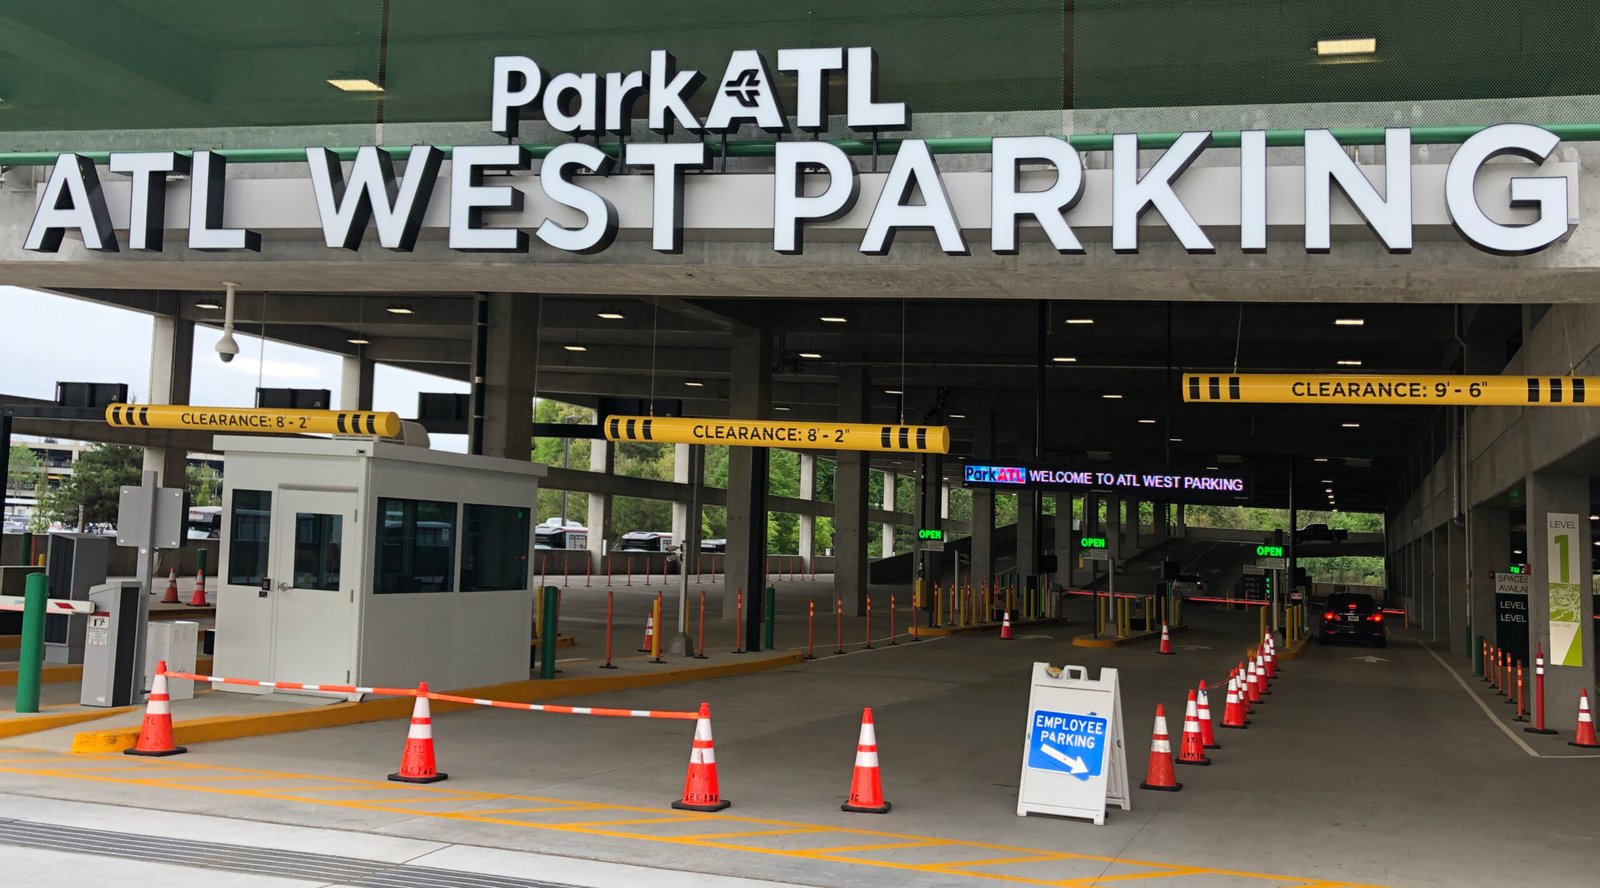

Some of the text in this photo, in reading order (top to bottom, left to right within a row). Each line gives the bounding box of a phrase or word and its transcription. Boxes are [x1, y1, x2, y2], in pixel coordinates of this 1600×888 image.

[491, 46, 907, 133] ParkATL
[23, 123, 1568, 254] ATL WEST PARKING
[1292, 382, 1427, 398] CLEARANCE:
[181, 412, 272, 428] CLEARANCE:
[693, 425, 802, 442] CLEARANCE:
[966, 466, 1243, 491] ParkATL WELCOME TO ATL WEST PARKING
[1549, 520, 1577, 530] LEVEL
[918, 529, 942, 540] OPEN
[1081, 537, 1106, 548] OPEN
[1256, 545, 1283, 557] OPEN
[1554, 534, 1570, 583] 1
[1500, 601, 1526, 610] LEVEL
[1500, 614, 1526, 622] LEVEL
[1036, 715, 1104, 735] EMPLOYEE
[1040, 730, 1096, 749] PARKING
